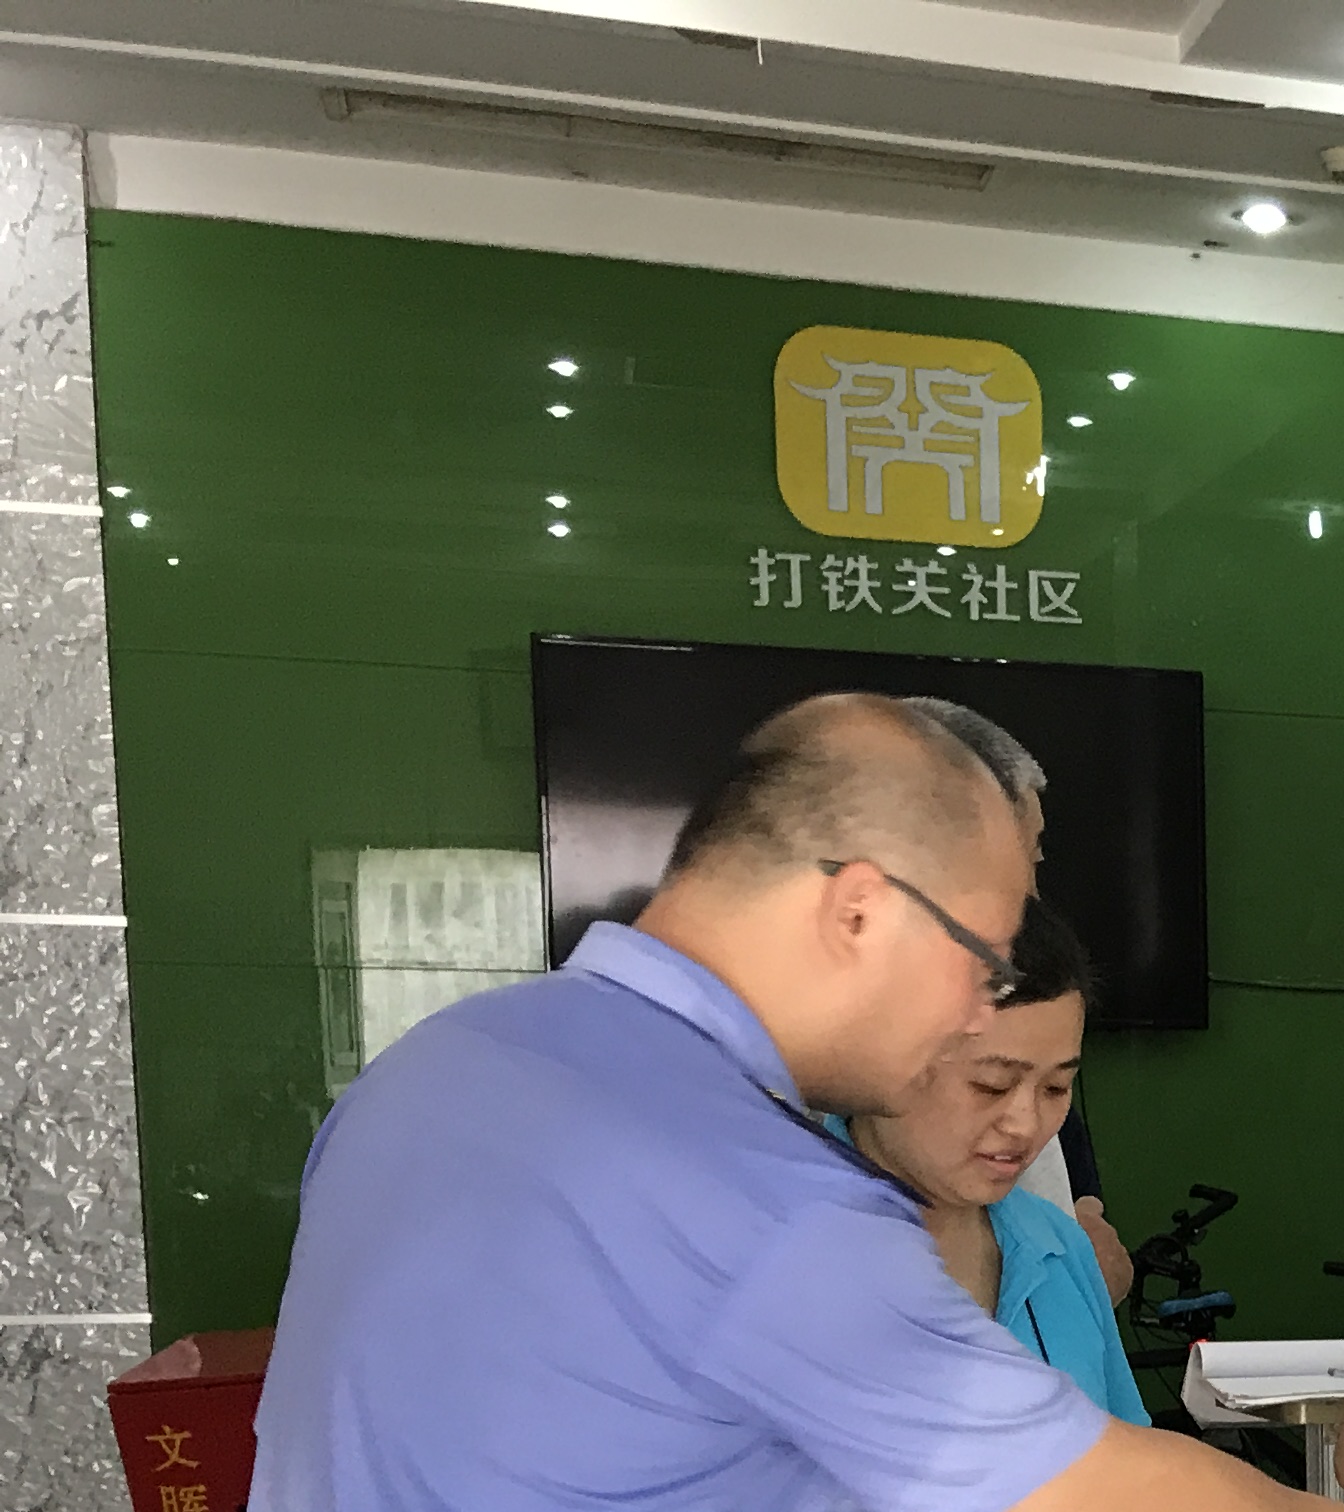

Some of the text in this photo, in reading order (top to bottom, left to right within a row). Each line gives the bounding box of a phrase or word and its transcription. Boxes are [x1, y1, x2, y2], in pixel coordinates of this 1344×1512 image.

[146, 425, 229, 647] 文晖街道
[749, 549, 1082, 625] 打铁关社区
